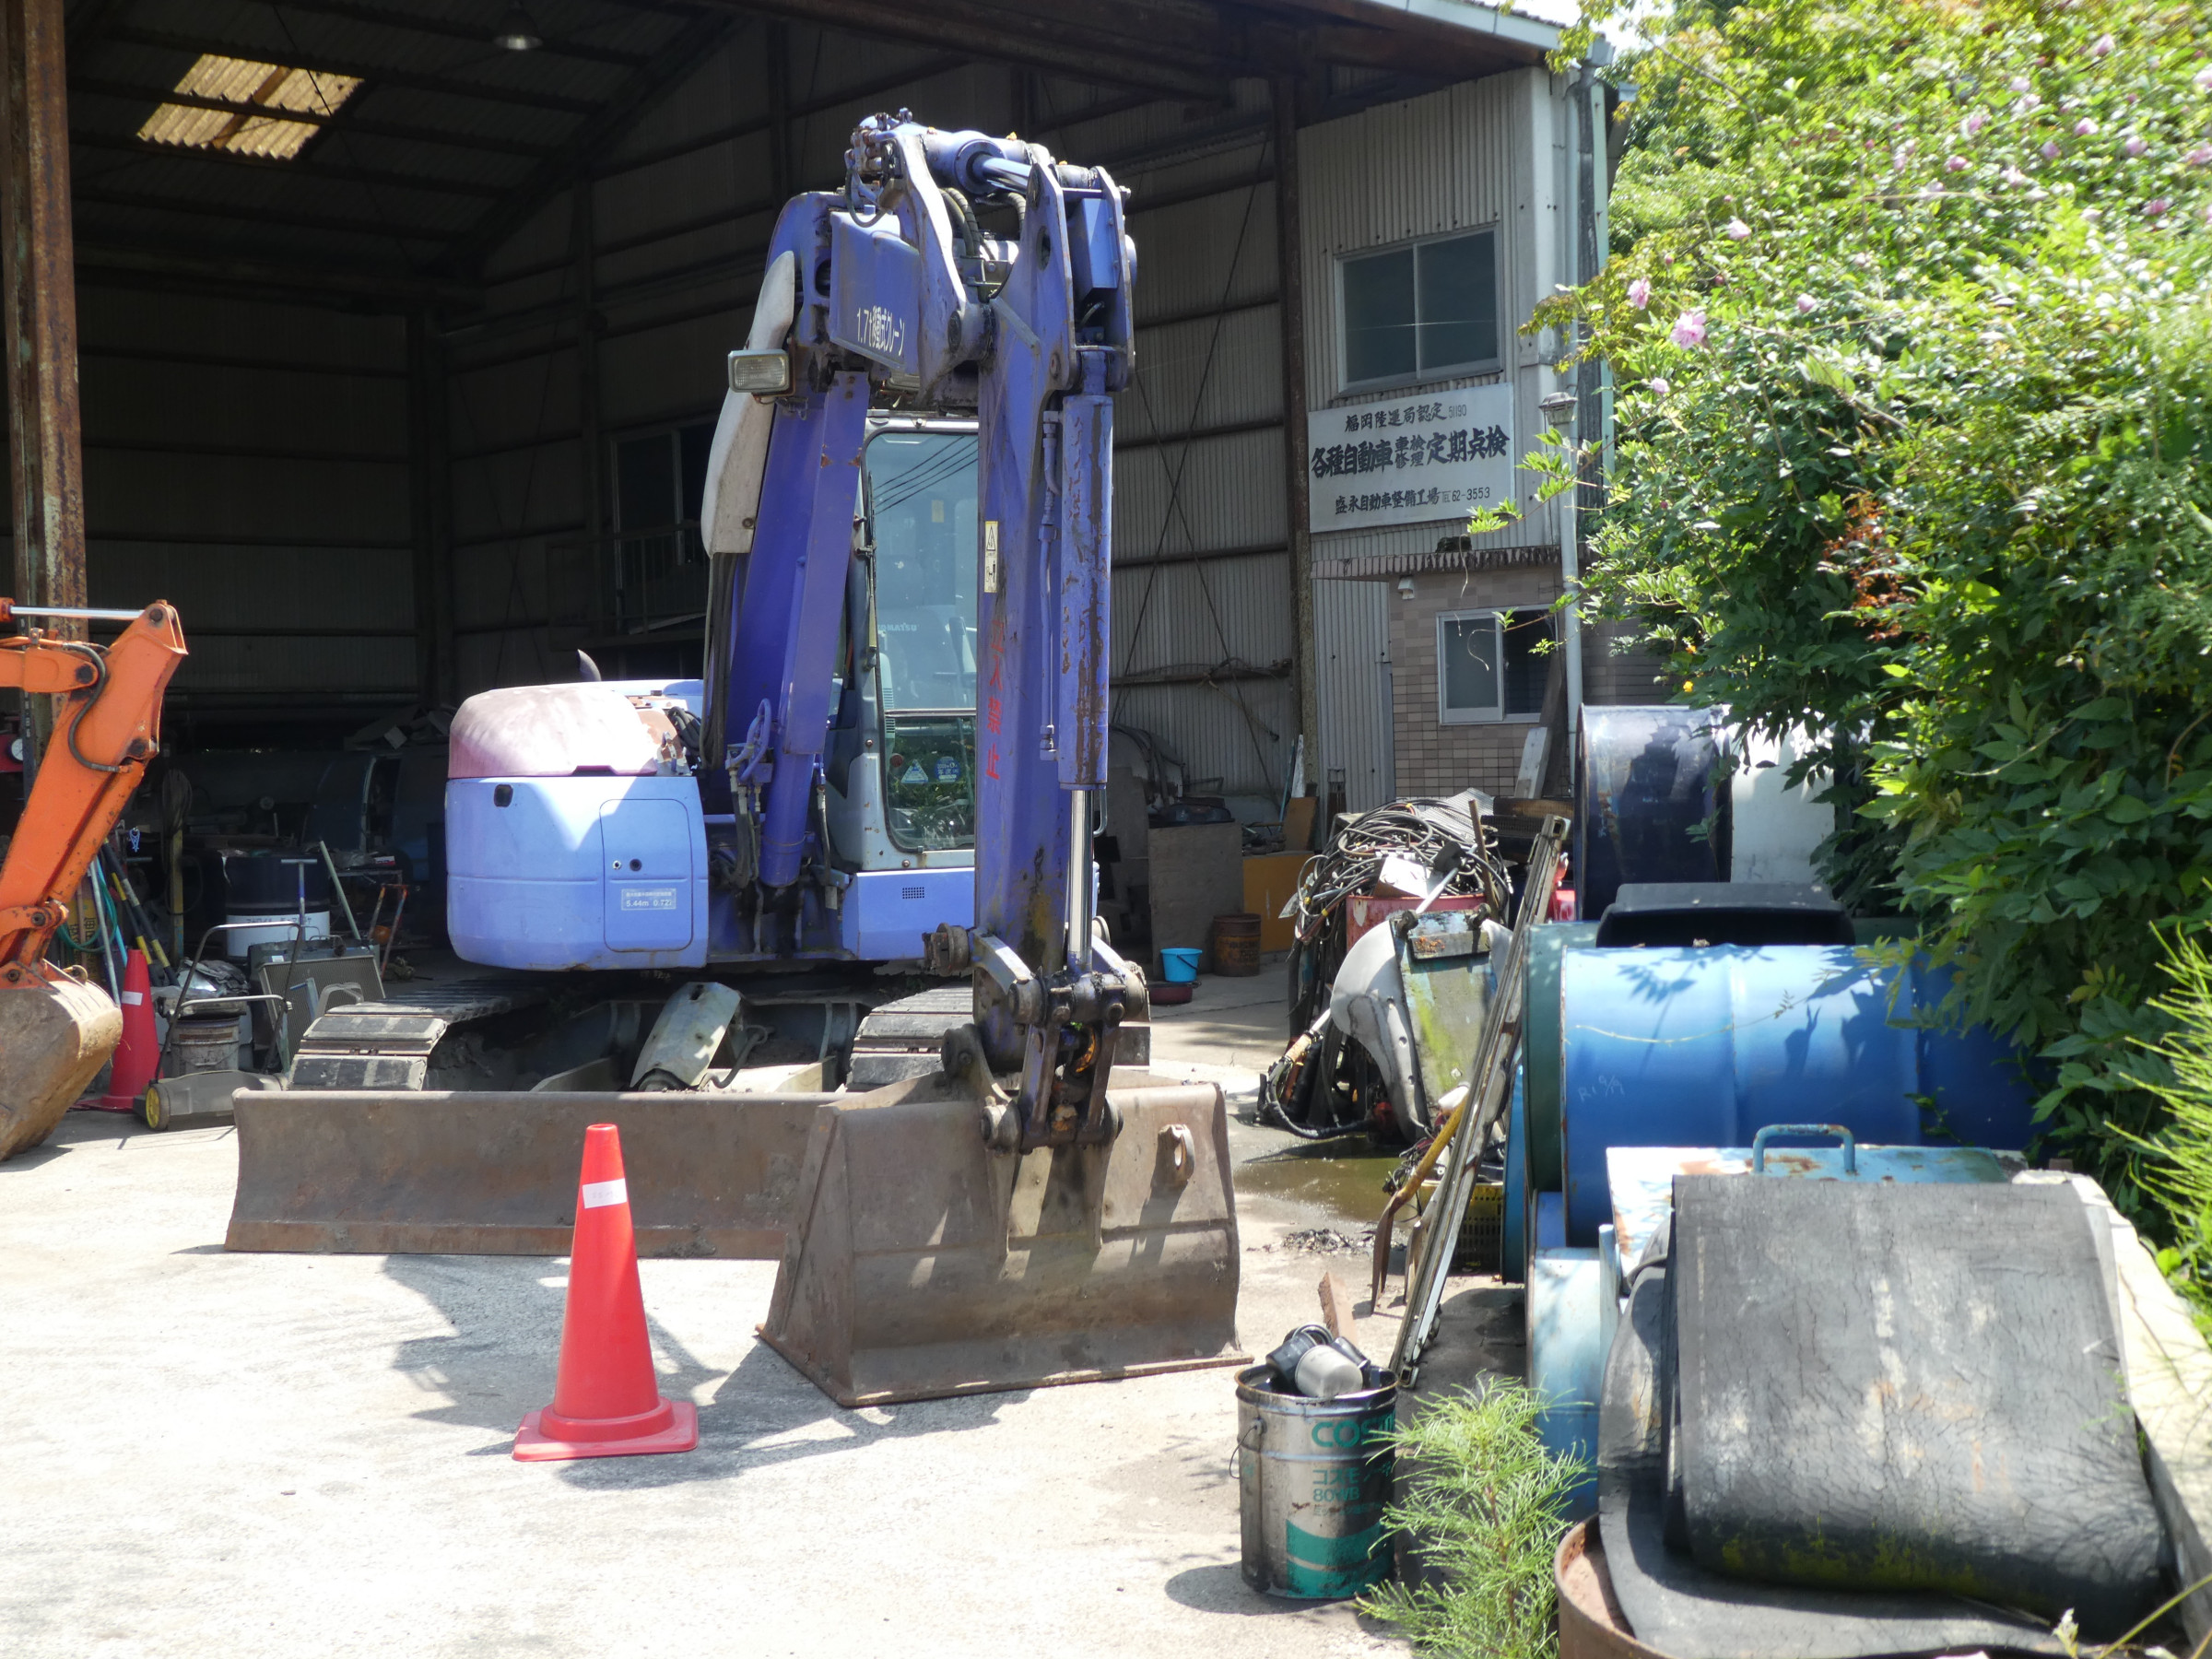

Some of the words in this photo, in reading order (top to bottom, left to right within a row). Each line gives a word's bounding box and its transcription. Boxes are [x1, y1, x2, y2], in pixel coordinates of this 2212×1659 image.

[1312, 439, 1394, 478] 各種自動車
[1395, 434, 1427, 453] 車検
[1427, 424, 1511, 465] 定期点検
[1452, 487, 1490, 502] 62-3553
[1312, 1487, 1360, 1502] 80WB
